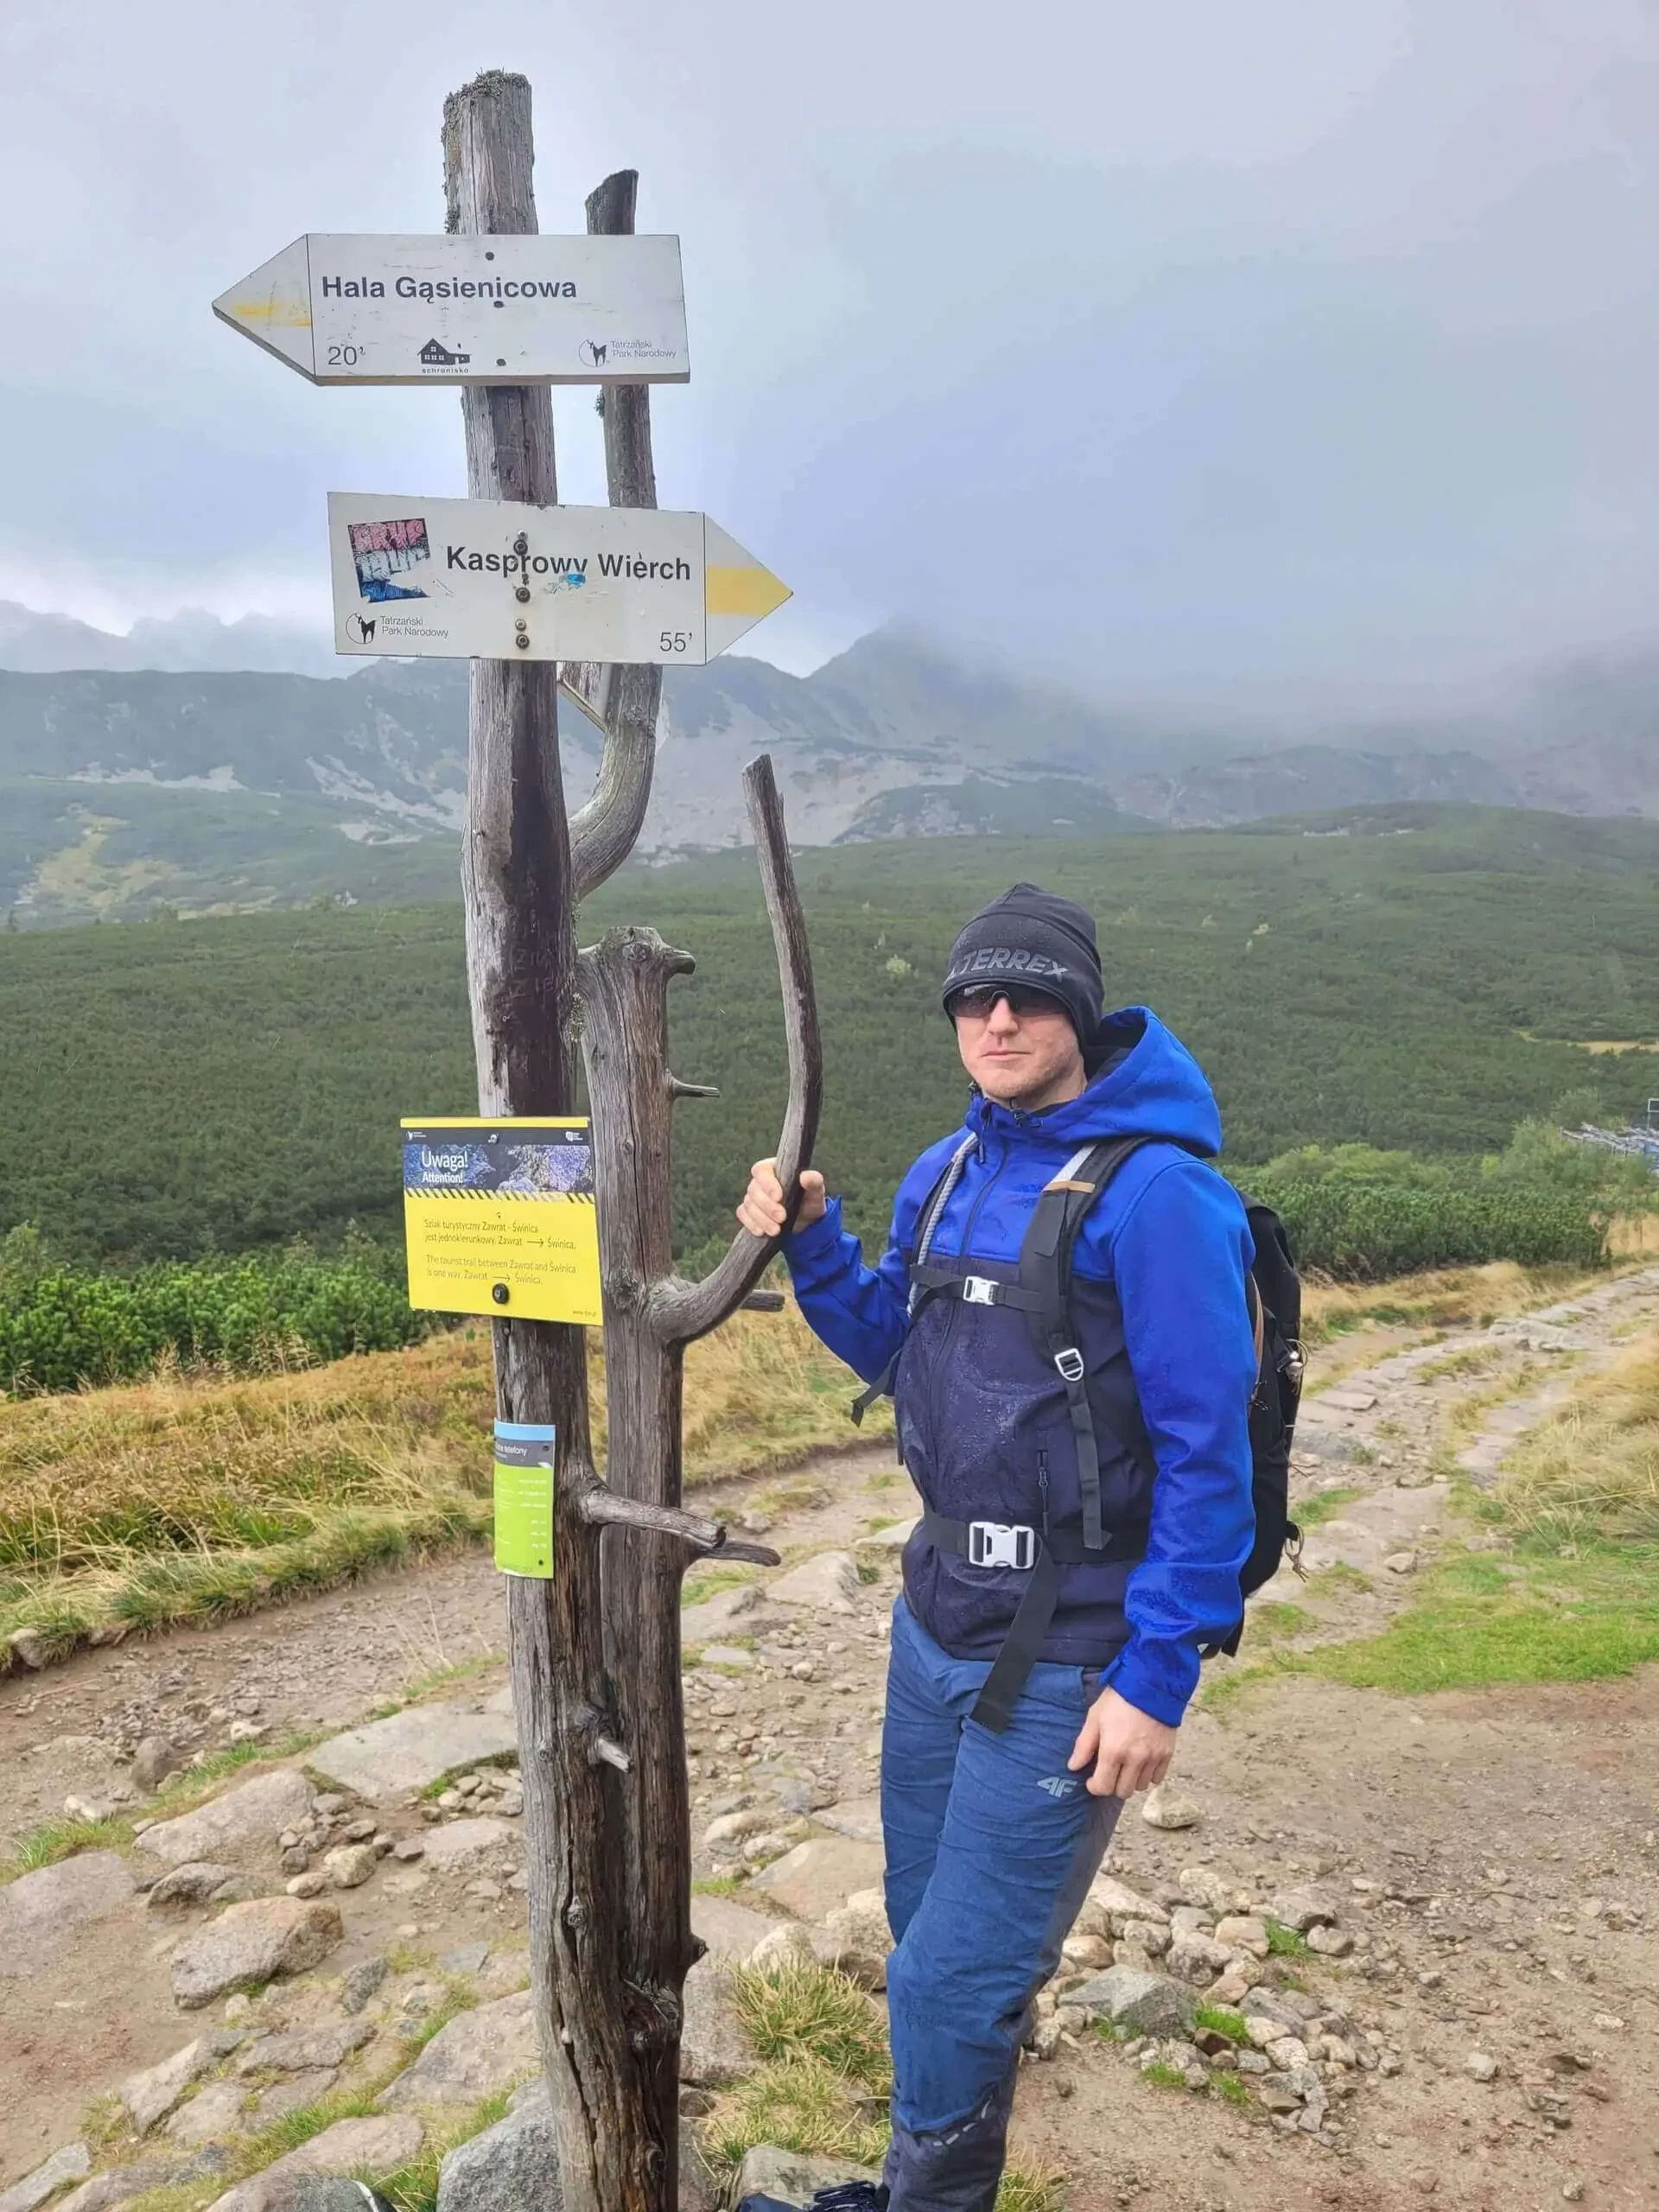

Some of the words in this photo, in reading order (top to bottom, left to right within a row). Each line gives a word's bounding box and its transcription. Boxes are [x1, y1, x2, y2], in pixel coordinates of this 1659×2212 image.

[321, 276, 385, 298] Hala
[395, 276, 577, 304] Gąsienicowa
[611, 340, 652, 350] Tatrzański
[634, 350, 677, 359] Narodowy
[597, 551, 691, 581] Wierch
[379, 615, 423, 626] Tatrzański
[382, 626, 402, 636] Park
[404, 627, 448, 639] Narodowy
[421, 1150, 468, 1172] Uwaga!
[422, 1172, 464, 1184] Attention!
[424, 1219, 441, 1229] Szlak
[482, 1221, 505, 1231] Zawrat
[499, 1235, 523, 1246] Zawrat
